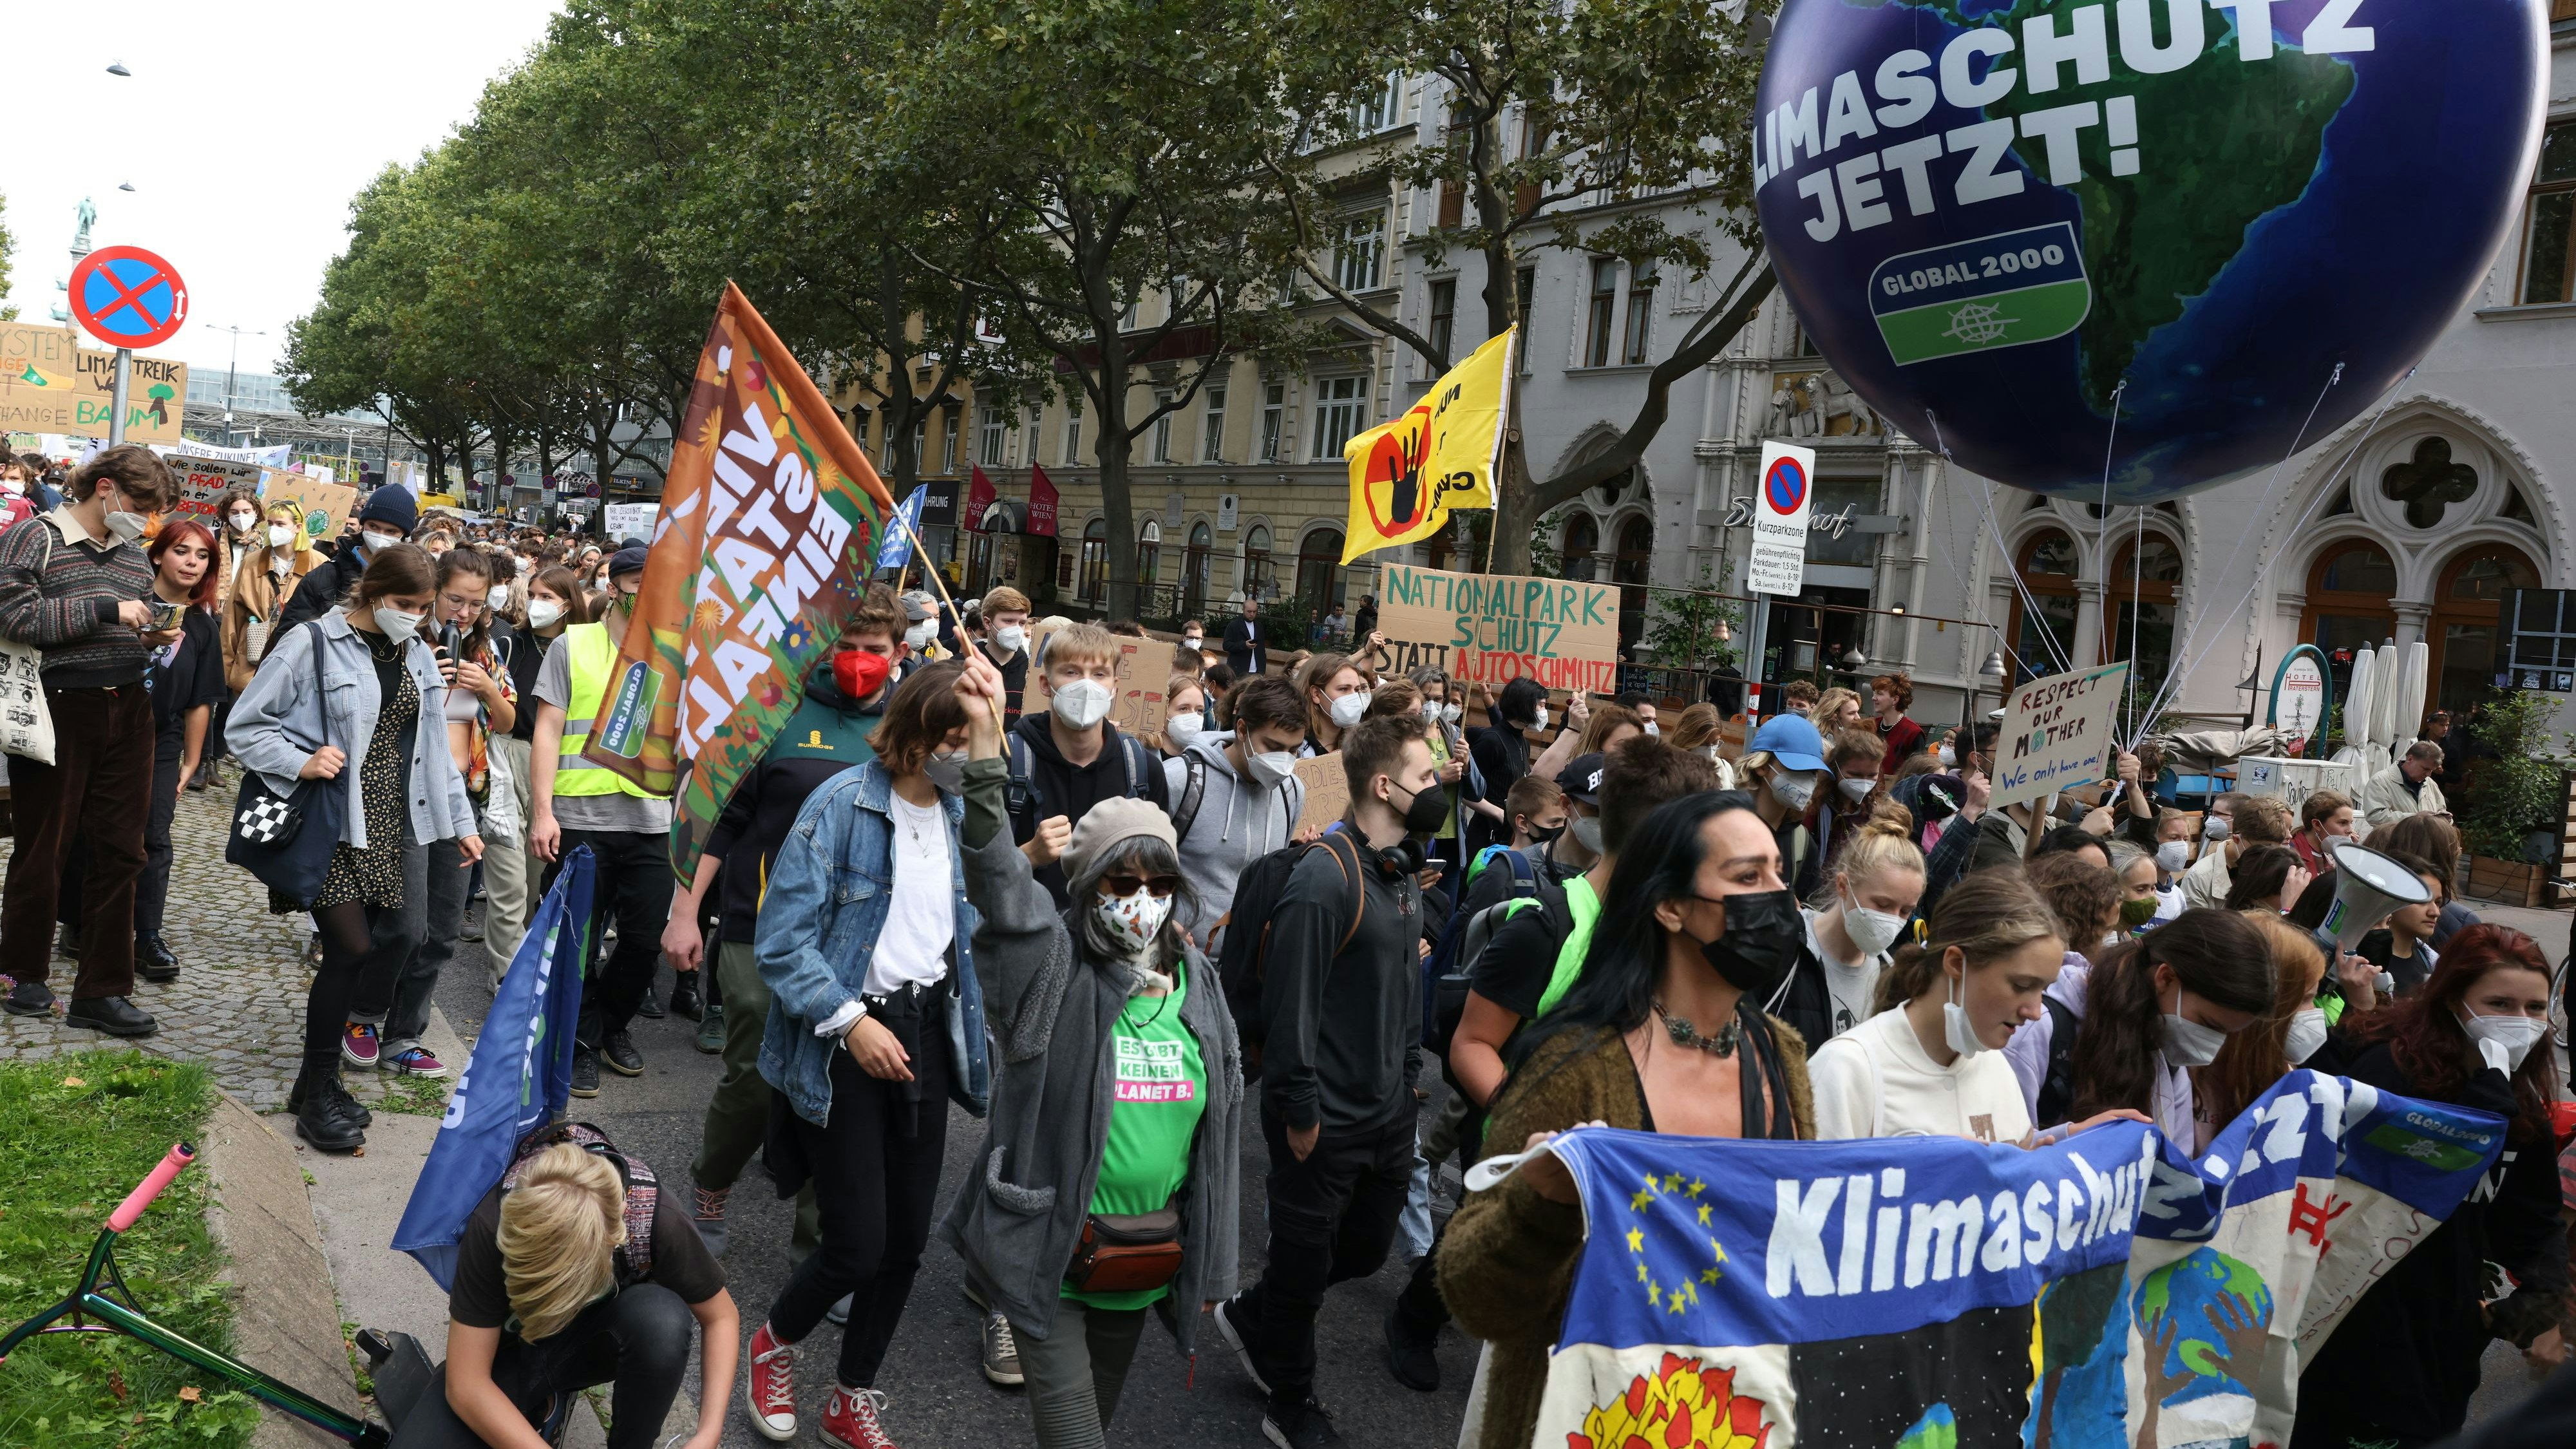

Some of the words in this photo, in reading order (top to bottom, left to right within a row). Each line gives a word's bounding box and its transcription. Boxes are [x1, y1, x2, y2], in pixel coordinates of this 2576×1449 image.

[1797, 95, 2141, 243] JETZT!
[1882, 261, 1979, 296] GLOBAL
[1980, 244, 2065, 278] 2000
[167, 459, 189, 470] Wie
[193, 462, 227, 475] sollen
[231, 468, 252, 477] wir
[187, 473, 225, 489] PFAD
[194, 491, 209, 500] er
[1030, 502, 1056, 513] HOTEL
[1032, 510, 1052, 520] WIEN
[1757, 520, 1804, 538] Kurzparkzone
[1756, 547, 1801, 562] gebührenpflichtig
[1751, 567, 1768, 578] Mo.-Fr.
[1768, 572, 1783, 580] (werkt.)
[1753, 558, 1782, 570] Parkdauer:
[1790, 563, 1801, 573] Std.
[1754, 578, 1763, 587] Sa.
[1387, 566, 1615, 627] NATIONALPARK-
[1450, 616, 1562, 658] SCHUTZ
[1374, 638, 1450, 674] STATT
[1455, 647, 1616, 694] AUTOSCHMUTZ
[2285, 673, 2322, 684] HOTEL
[2021, 674, 2101, 714] RESPECT
[2032, 705, 2063, 728] OUR
[2002, 764, 2027, 791] We
[2034, 759, 2057, 781] only
[2060, 759, 2079, 773] have
[2083, 749, 2103, 766] one!
[1778, 782, 1808, 803] ACT
[1120, 1040, 1140, 1055] ES
[1121, 1062, 1180, 1079] KEINEN
[1175, 1084, 1191, 1099] B.
